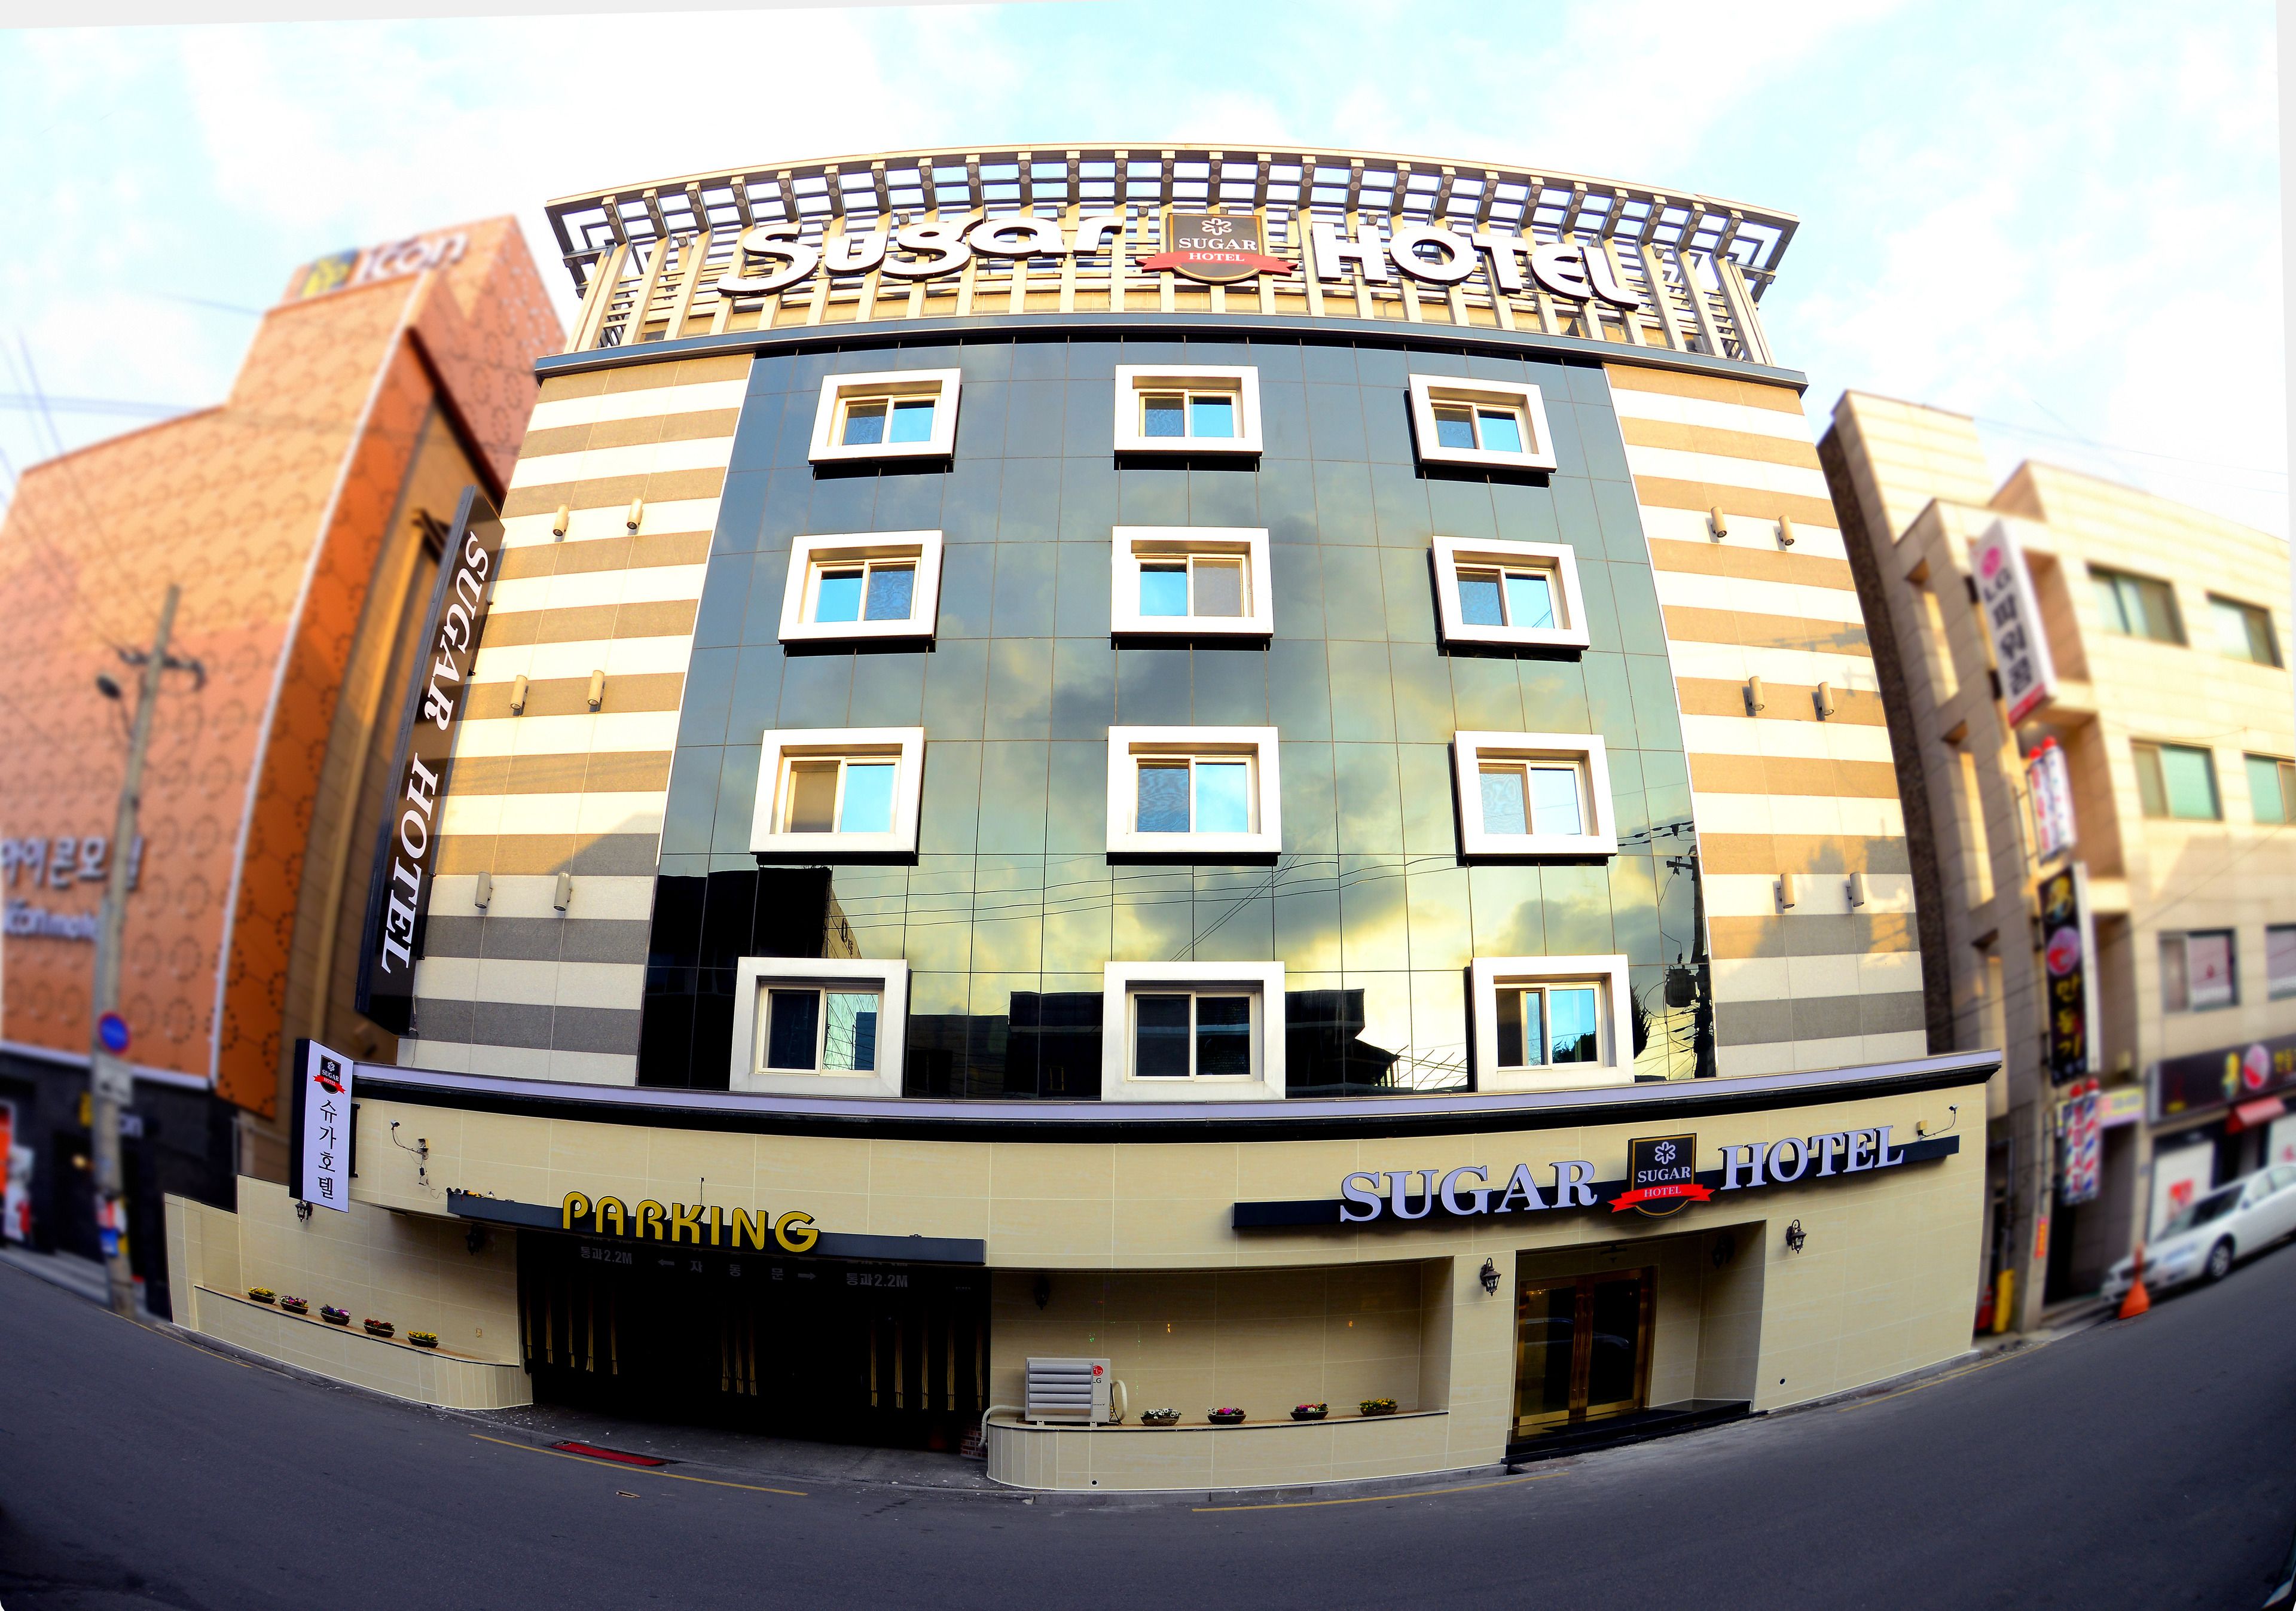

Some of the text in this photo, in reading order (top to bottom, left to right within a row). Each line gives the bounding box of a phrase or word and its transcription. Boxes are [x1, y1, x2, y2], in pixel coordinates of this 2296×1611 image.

[1178, 237, 1257, 251] SUGAR
[1189, 252, 1245, 262] HOTEL
[381, 530, 489, 975] SUGAR HOTEL
[0, 835, 145, 892] 아이콘모
[322, 1069, 339, 1082] SUGAR
[323, 1077, 336, 1086] HOTEL
[317, 1099, 337, 1200] 슈가호텔
[1340, 1125, 1904, 1222] SUGAR HOTEL
[1637, 1166, 1691, 1183] SUGAR
[1644, 1186, 1681, 1197] HOTEL
[563, 1191, 821, 1253] PARKING
